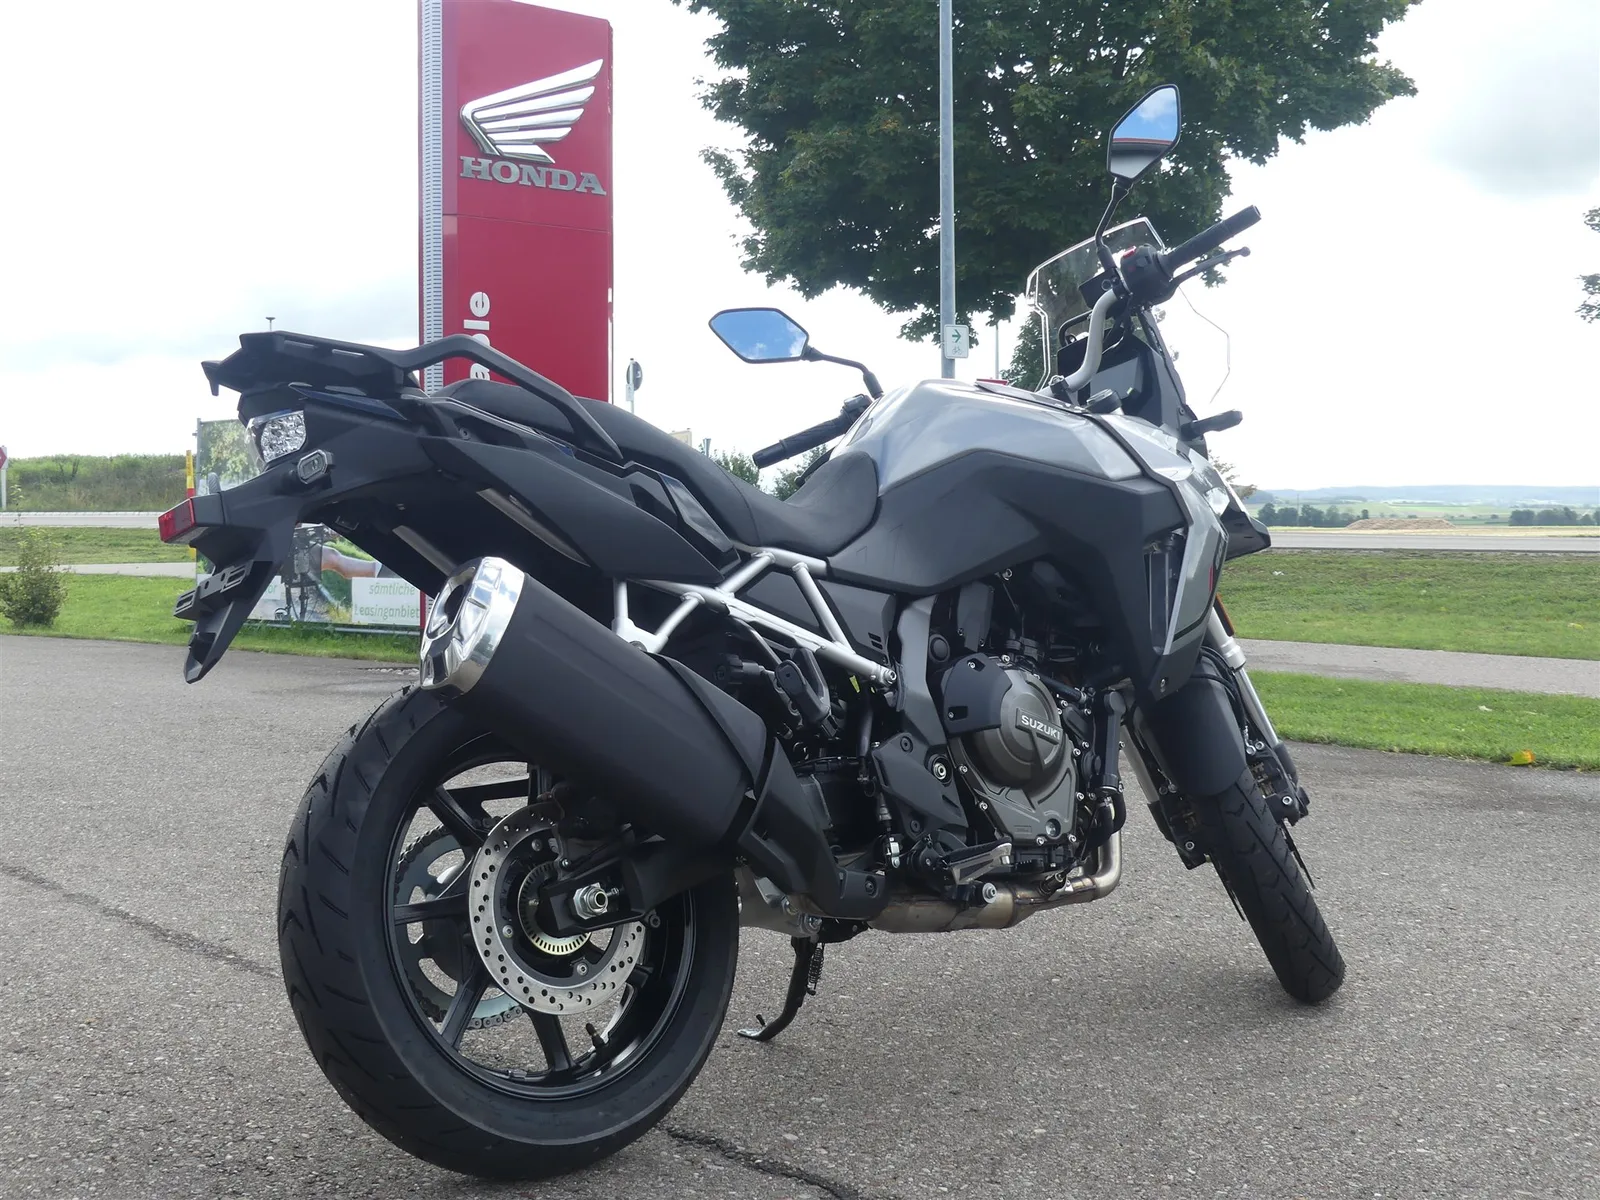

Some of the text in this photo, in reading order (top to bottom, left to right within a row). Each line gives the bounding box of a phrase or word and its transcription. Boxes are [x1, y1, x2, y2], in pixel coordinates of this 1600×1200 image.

[460, 156, 607, 196] HONDA
[369, 582, 415, 596] sämtliche
[1021, 714, 1060, 740] SUZUKI
